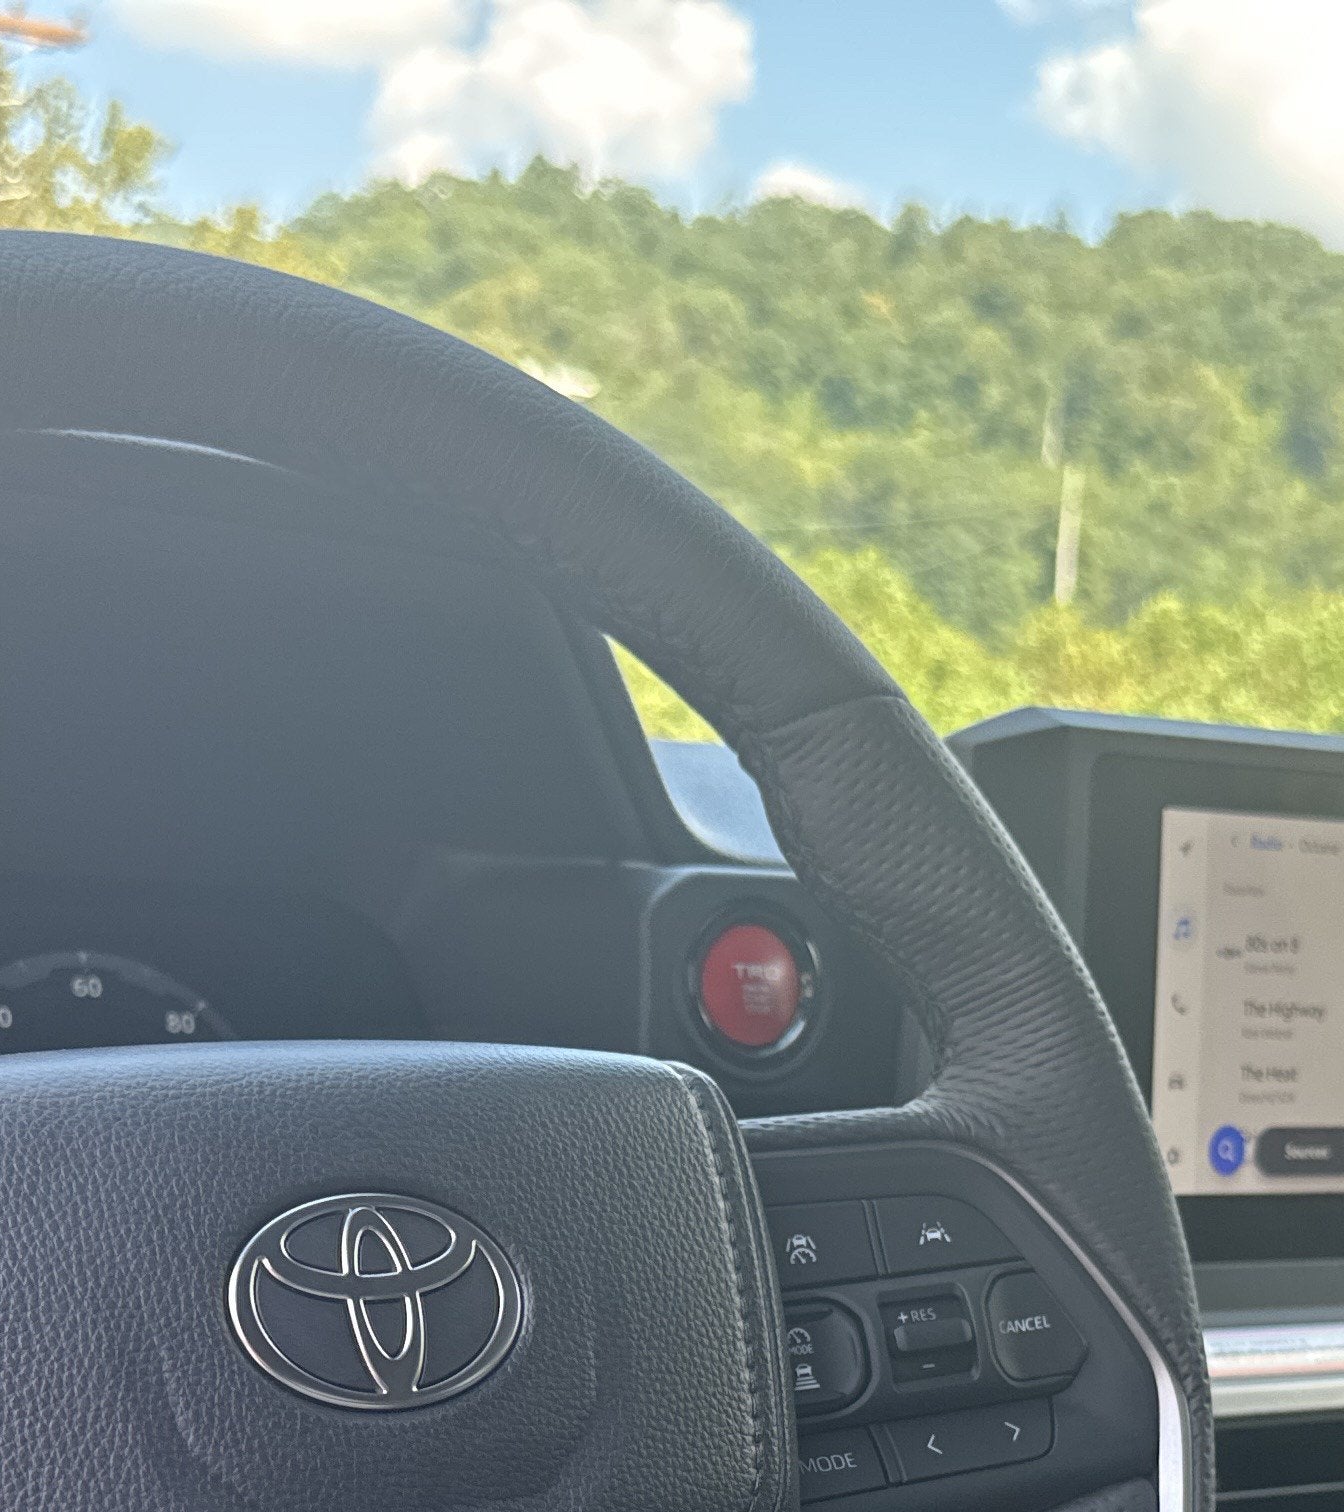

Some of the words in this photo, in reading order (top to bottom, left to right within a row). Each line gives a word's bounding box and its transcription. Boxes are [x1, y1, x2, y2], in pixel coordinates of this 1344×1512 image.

[71, 975, 103, 998] 60
[165, 1011, 196, 1034] 80
[998, 1315, 1051, 1335] CANCEL
